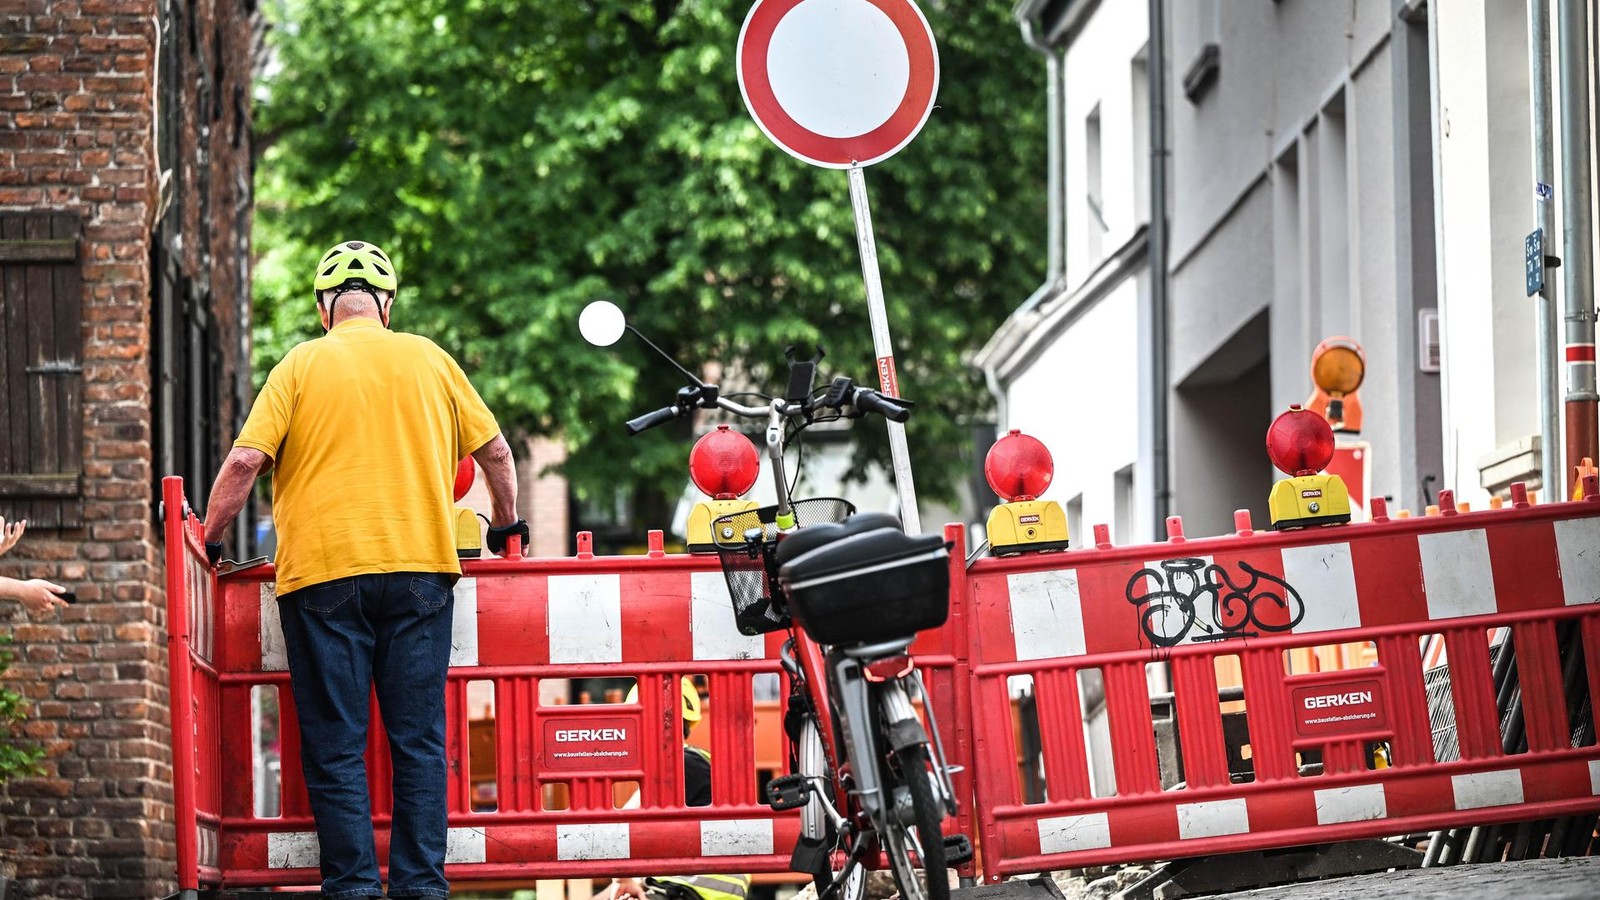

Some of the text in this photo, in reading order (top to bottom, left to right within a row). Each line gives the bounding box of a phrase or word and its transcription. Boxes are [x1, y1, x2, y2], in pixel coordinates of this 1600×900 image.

[880, 358, 892, 398] ERKEN
[1304, 691, 1373, 709] GERKEN
[1305, 713, 1376, 724] www.baustellen-absicherung.de
[555, 729, 626, 742] GERKEN
